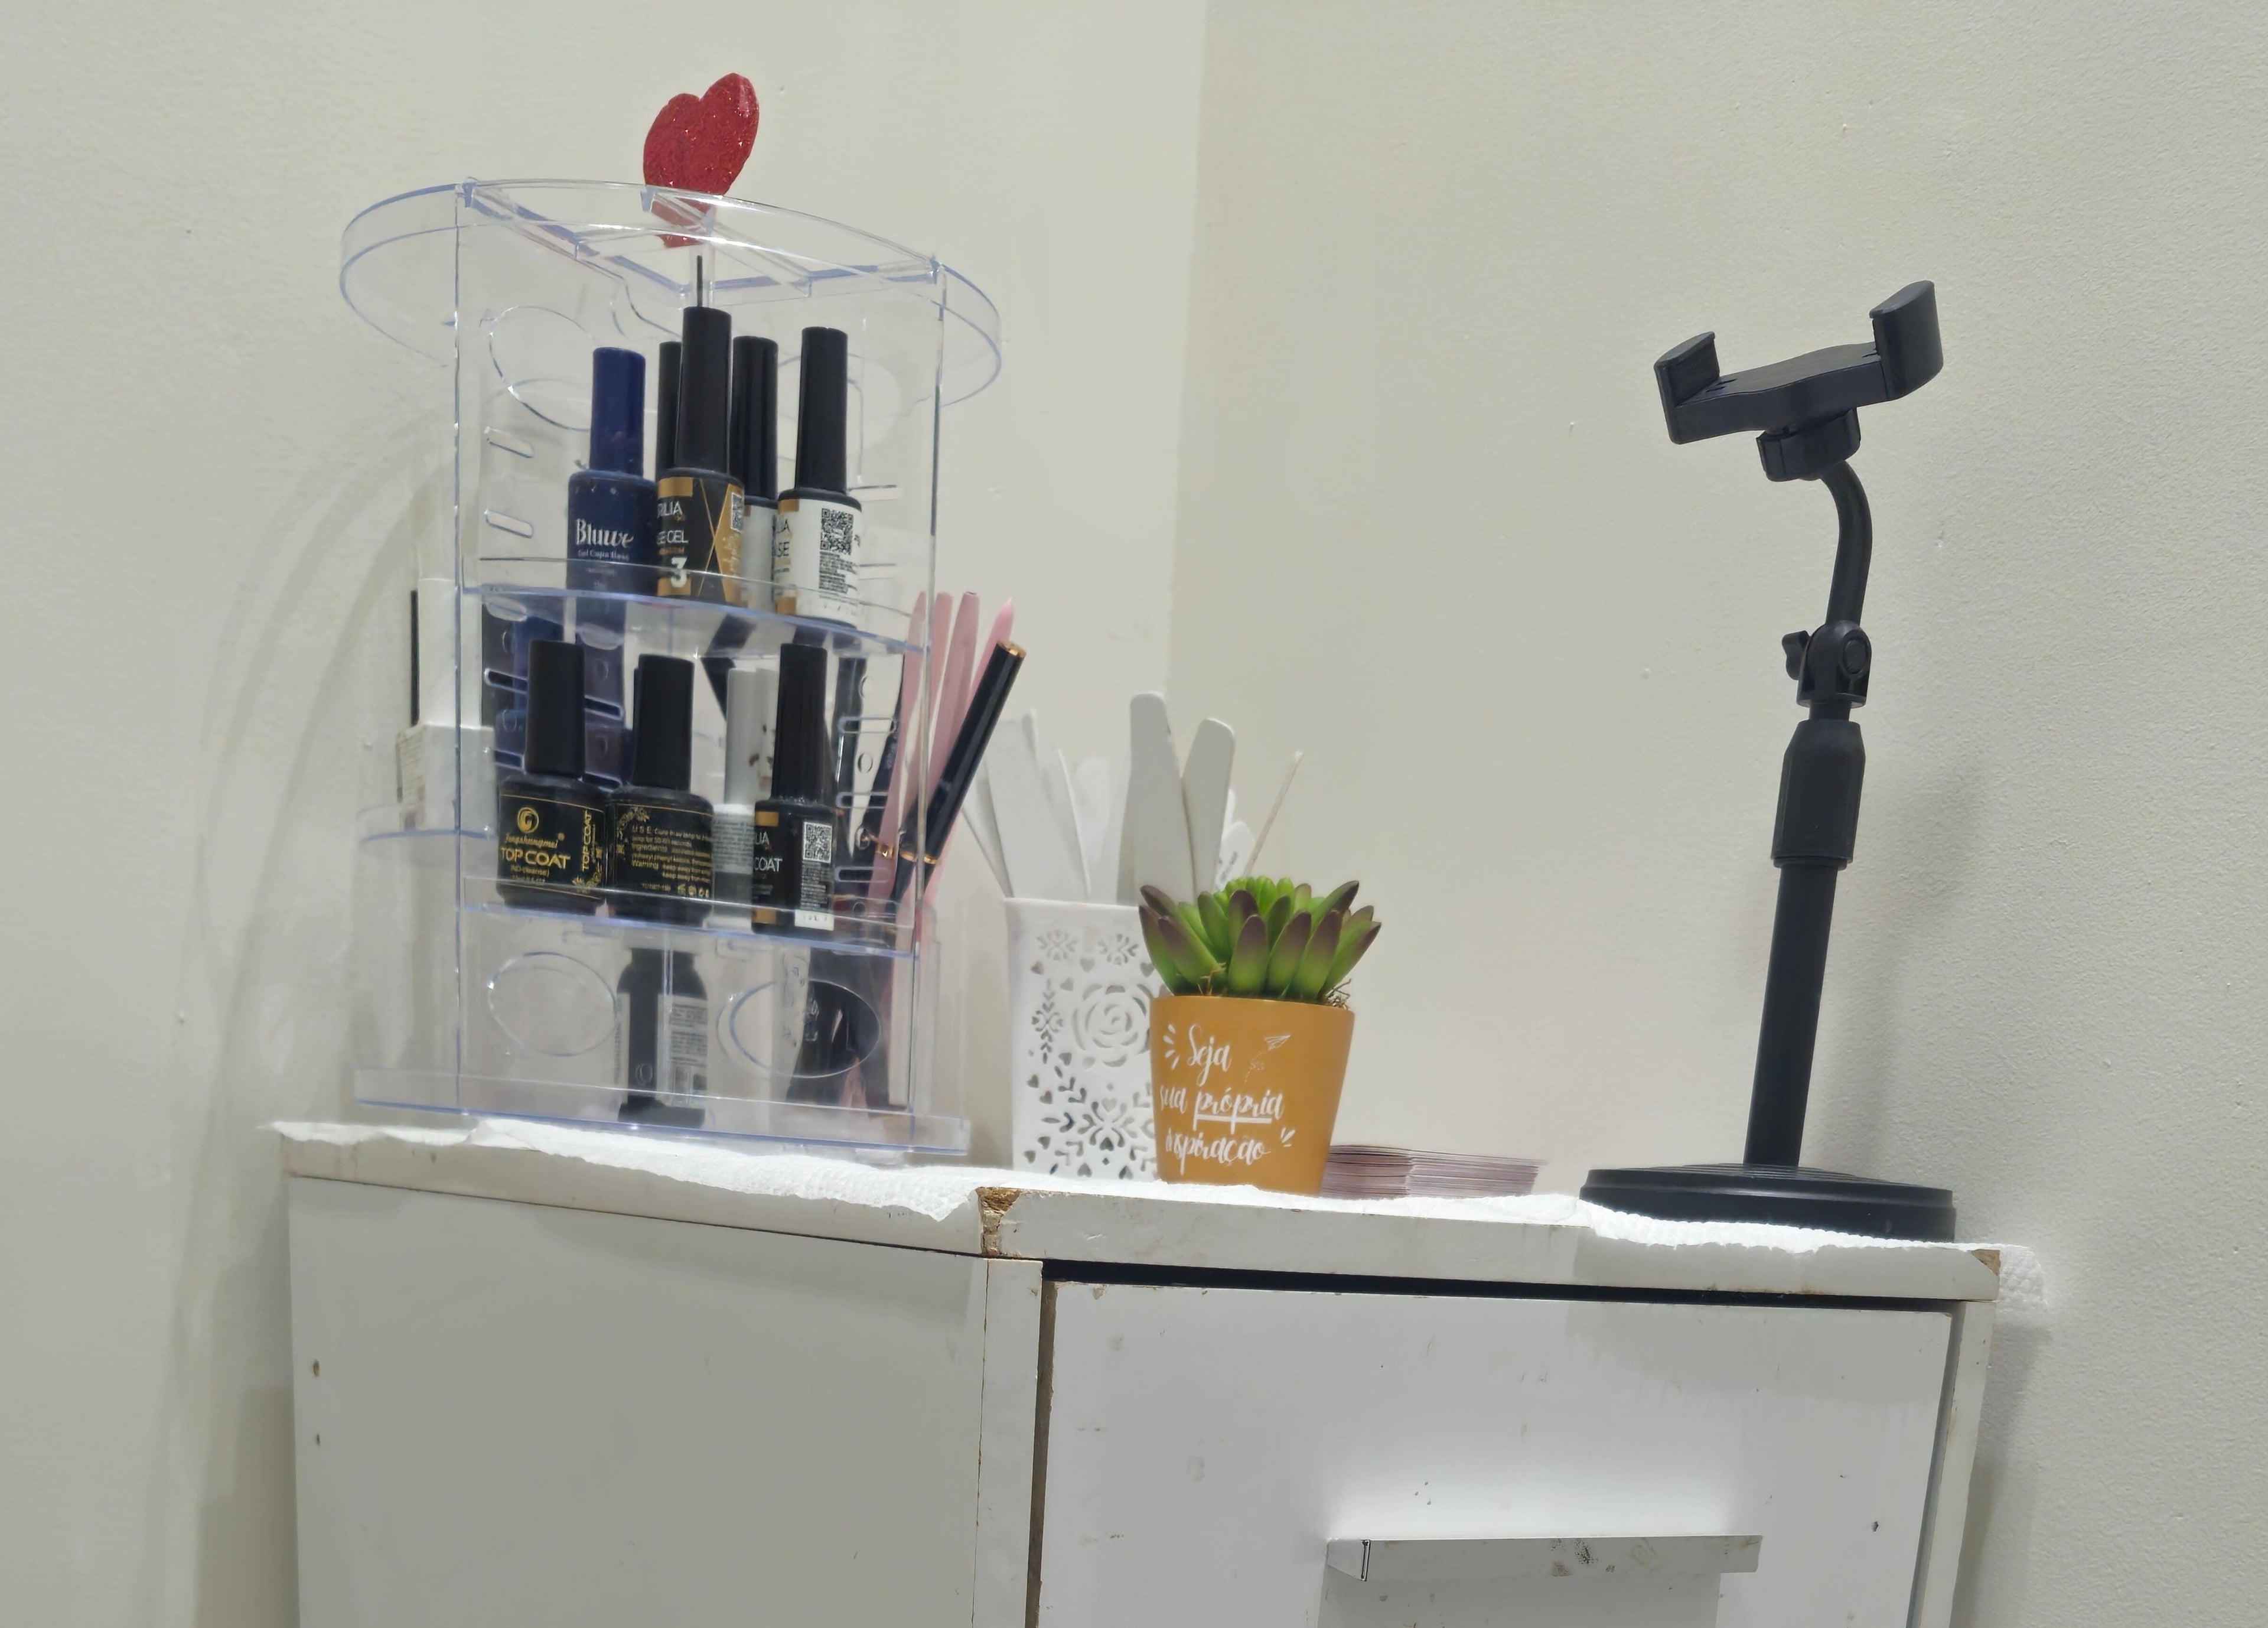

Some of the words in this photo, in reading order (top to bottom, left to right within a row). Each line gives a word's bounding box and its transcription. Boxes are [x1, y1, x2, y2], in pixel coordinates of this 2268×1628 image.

[670, 556, 687, 588] 3
[501, 846, 523, 862] TOP
[524, 850, 571, 870] COAT
[1187, 1024, 1233, 1087] Seja
[1159, 1085, 1187, 1113] sua
[1192, 1087, 1285, 1135] própria
